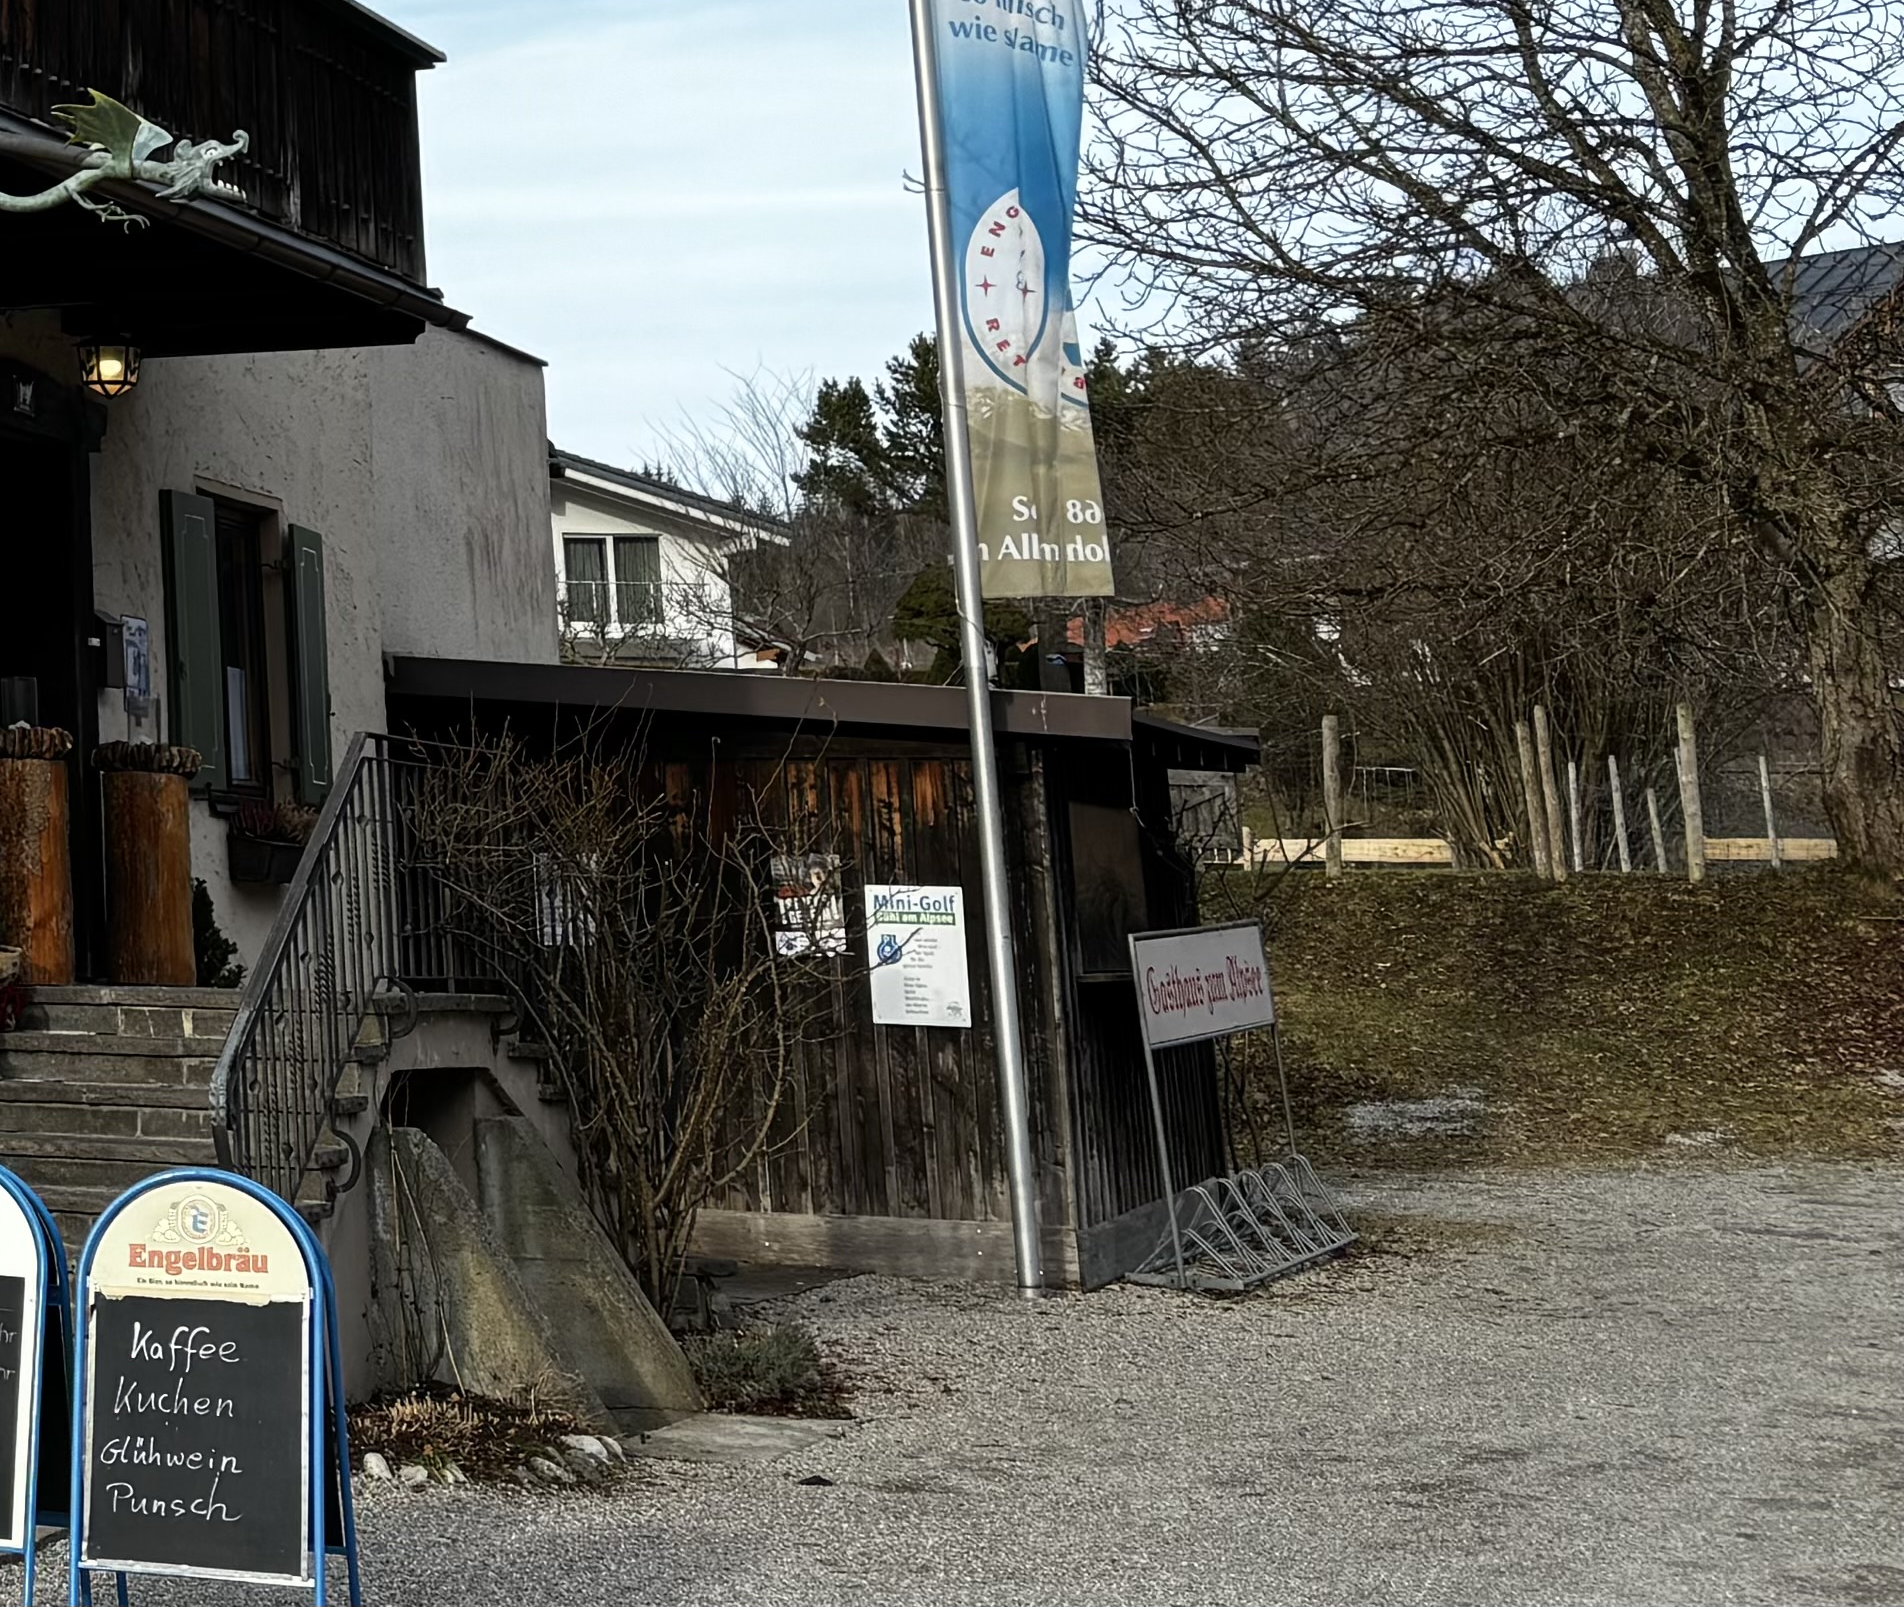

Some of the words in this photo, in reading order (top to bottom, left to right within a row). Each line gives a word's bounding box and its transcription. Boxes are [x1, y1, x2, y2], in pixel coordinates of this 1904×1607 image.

[949, 16, 997, 42] wie
[873, 894, 955, 912] Mini-Golf
[919, 913, 954, 924] Alpsee
[129, 1244, 269, 1276] Engelbräu
[131, 1321, 240, 1372] Kaffee
[114, 1375, 233, 1417] Kuchen
[100, 1436, 243, 1473] Glühwein
[106, 1474, 243, 1521] Punsch
